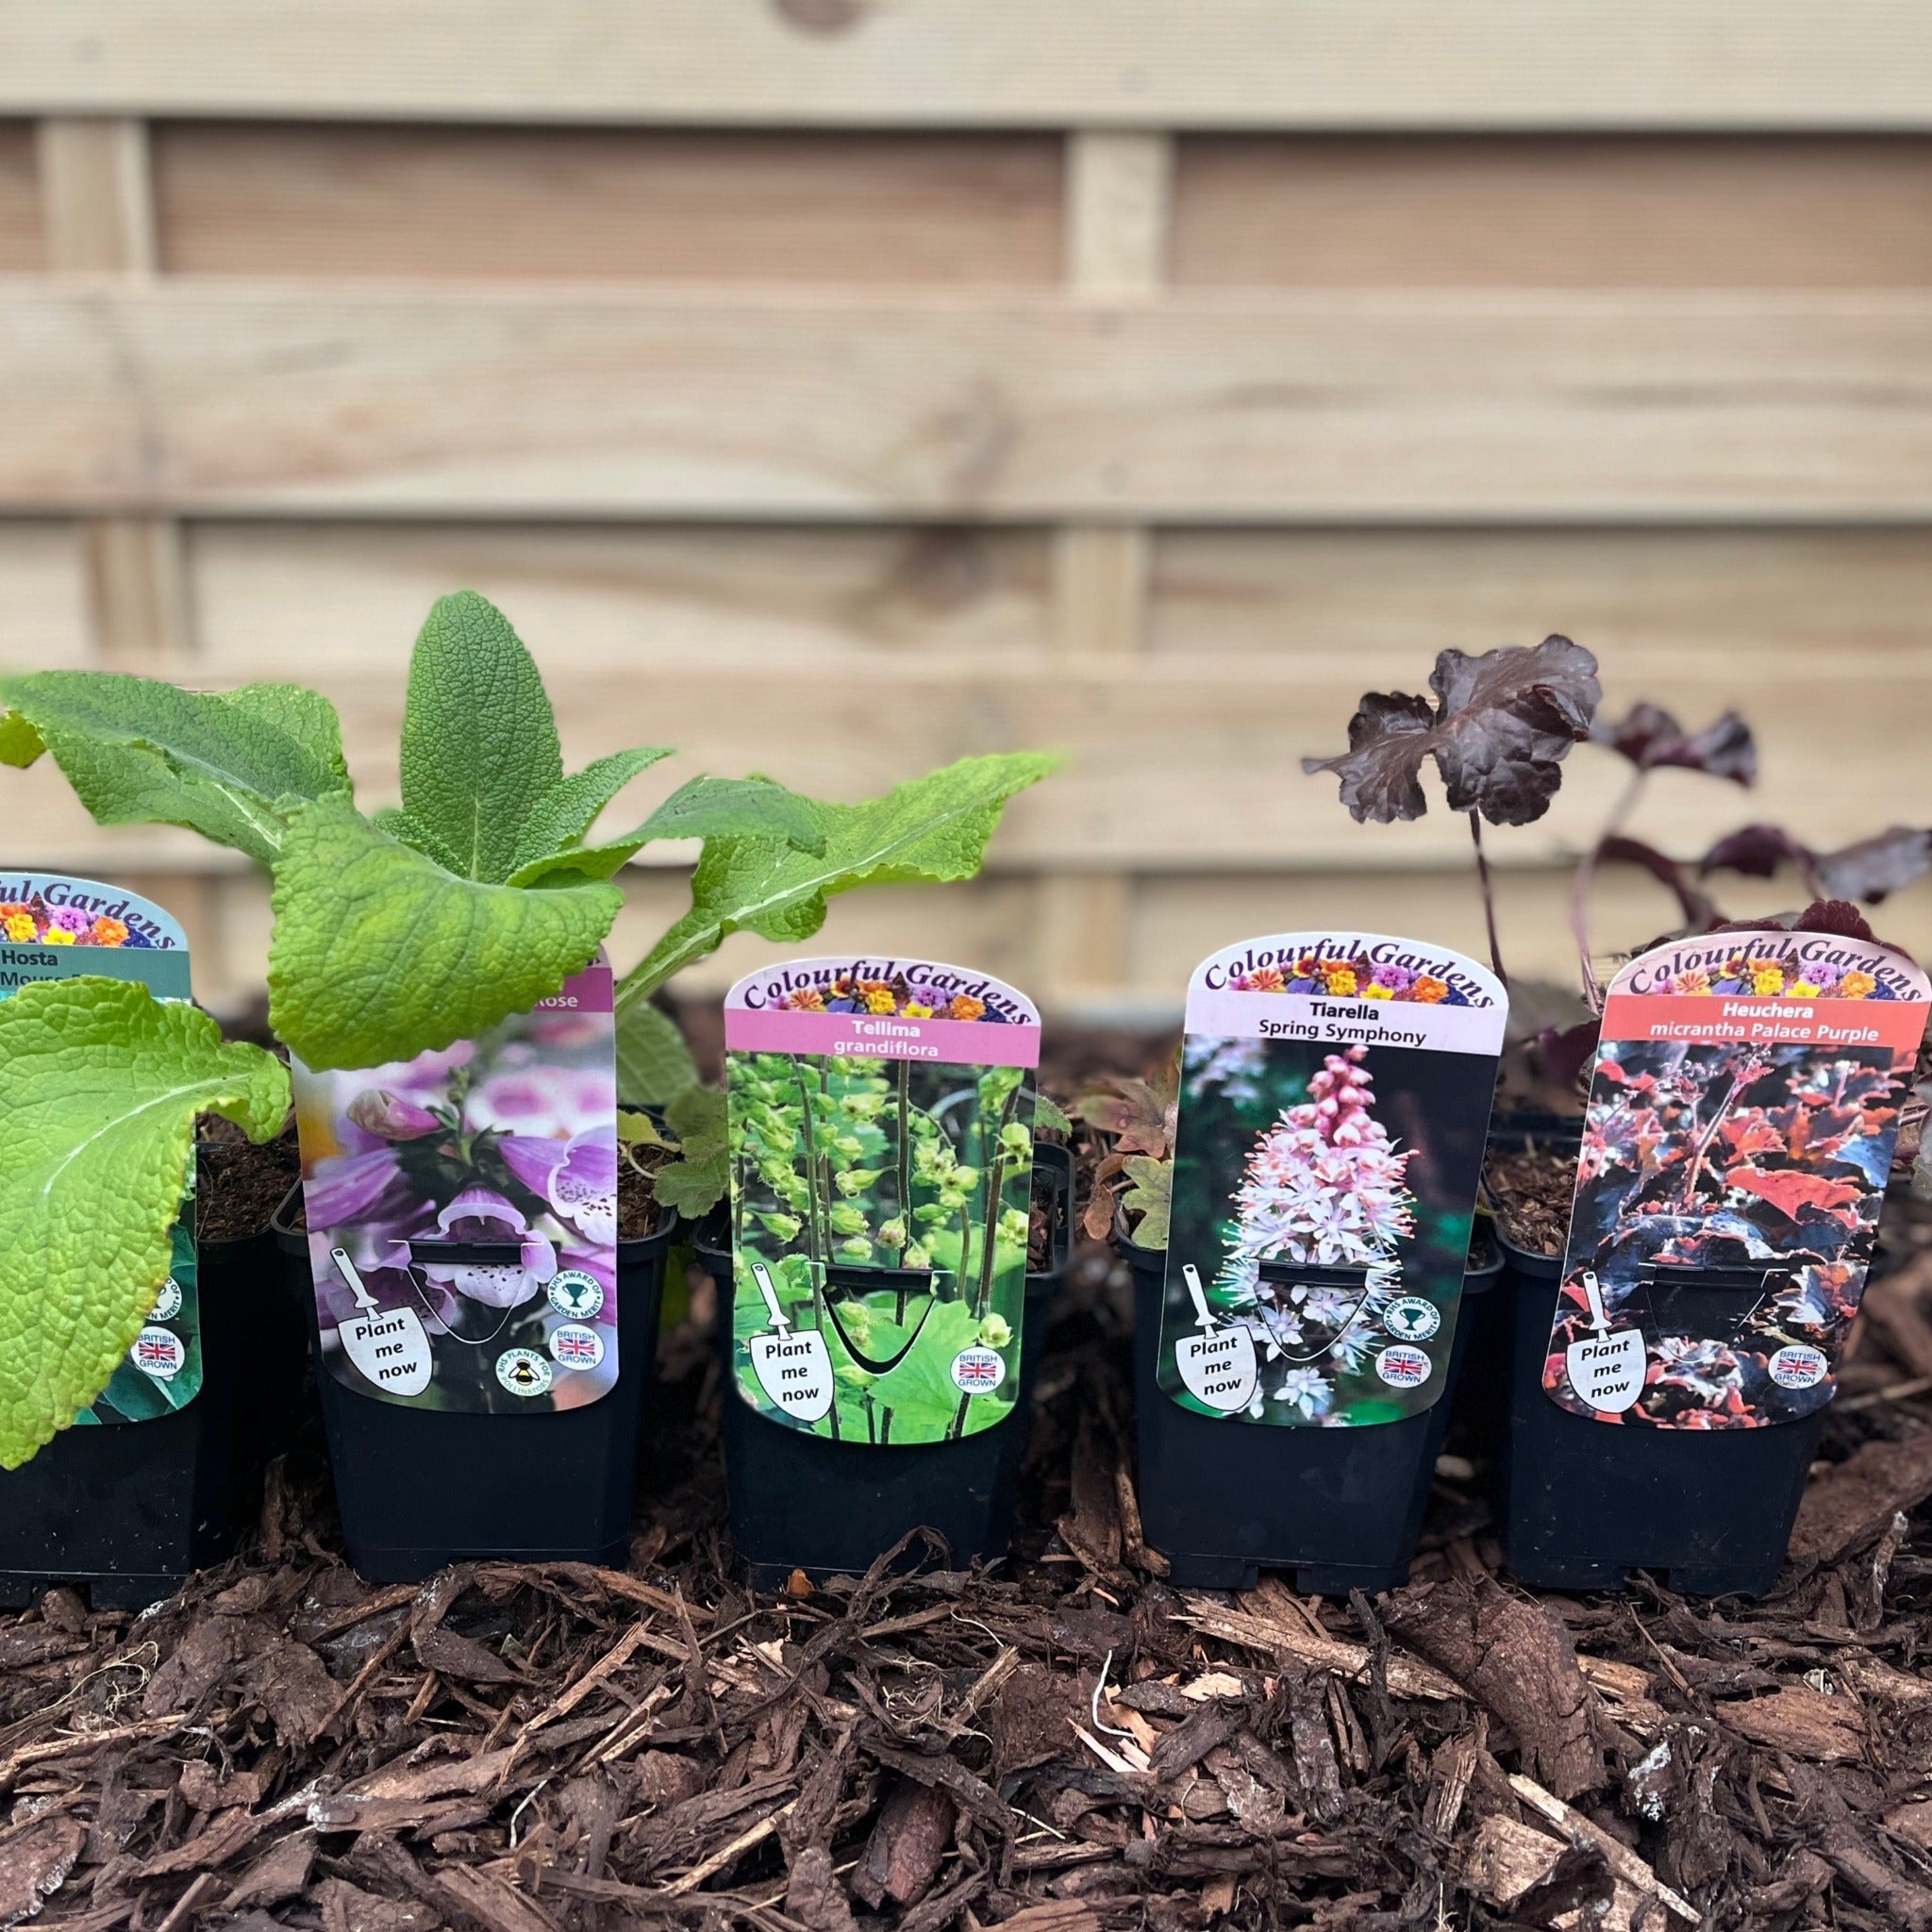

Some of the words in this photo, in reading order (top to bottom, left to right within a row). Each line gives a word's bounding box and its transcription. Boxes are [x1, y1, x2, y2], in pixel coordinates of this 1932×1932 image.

[43, 883, 176, 949] Gardens
[1, 950, 58, 966] Hosta
[1205, 939, 1360, 990] Colourful
[1371, 943, 1494, 1008] Gardens
[1629, 938, 1792, 995] Colourful
[1800, 940, 1923, 1002] Gardens
[744, 960, 895, 1009] Colourful
[906, 964, 1031, 1024] Gardens
[1309, 1002, 1379, 1021] Tiarella
[1723, 1002, 1814, 1019] Heuchera
[853, 1020, 921, 1038] Tellima
[1258, 1020, 1319, 1040] Spring
[1325, 1024, 1426, 1046] Symphony
[1650, 1022, 1745, 1038] micrantha
[1751, 1023, 1811, 1039] Palace
[1816, 1024, 1879, 1042] Purple
[834, 1041, 939, 1058] grandiflora
[549, 1276, 562, 1291] RHS
[563, 1271, 594, 1284] AWARD
[592, 1284, 602, 1298] OF
[160, 1300, 180, 1320] MERIT
[550, 1296, 578, 1318] GARDEN
[581, 1300, 601, 1318] MERIT
[1387, 1301, 1401, 1314] RHS
[1402, 1297, 1433, 1310] AWARD
[1430, 1310, 1440, 1320] OF
[138, 1334, 175, 1343] BRITISH
[356, 1319, 406, 1341] Plant
[557, 1330, 595, 1340] BRITISH
[1385, 1319, 1411, 1340] GARDEN
[1414, 1324, 1437, 1340] MERIT
[375, 1343, 404, 1358] me
[765, 1341, 812, 1359] Plant
[1190, 1337, 1238, 1357] Plant
[1385, 1350, 1424, 1360] BRITISH
[1581, 1340, 1630, 1361] Plant
[1779, 1350, 1822, 1361] BRITISH
[139, 1359, 177, 1370] GROWN
[498, 1358, 508, 1373] RHS
[507, 1350, 540, 1361] PLANTS
[539, 1361, 551, 1375] FOR
[558, 1354, 596, 1365] GROWN
[1205, 1360, 1232, 1374] me
[378, 1362, 418, 1380] now
[781, 1366, 808, 1379] me
[1382, 1372, 1421, 1383] GROWN
[1593, 1362, 1622, 1378] me
[1774, 1373, 1815, 1384] GROWN
[501, 1375, 549, 1395] POLLINATORS
[1204, 1377, 1241, 1395] now
[1591, 1380, 1630, 1398] now
[782, 1387, 820, 1402] now
